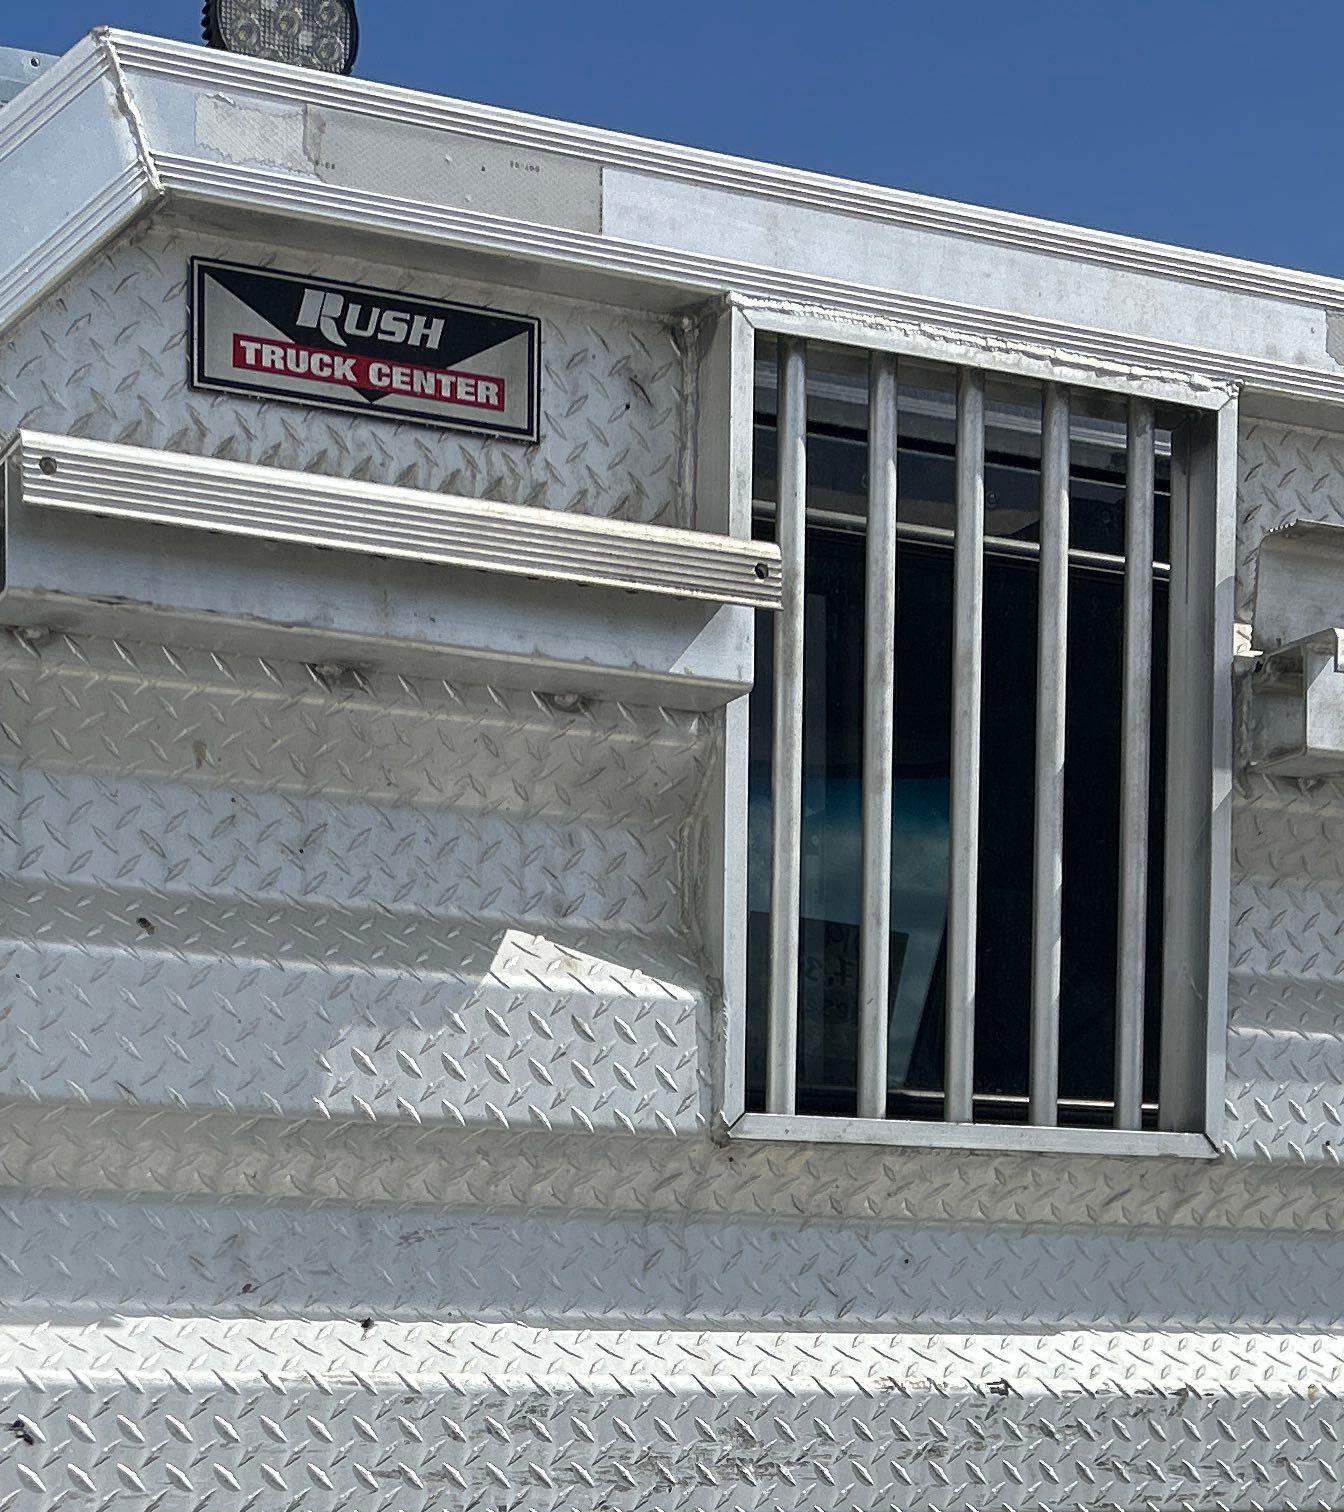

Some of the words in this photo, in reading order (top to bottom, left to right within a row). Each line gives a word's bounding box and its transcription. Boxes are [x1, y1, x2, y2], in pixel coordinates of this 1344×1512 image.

[296, 288, 446, 350] RUSH
[239, 340, 357, 382] TRUCK
[368, 361, 500, 406] CENTER
